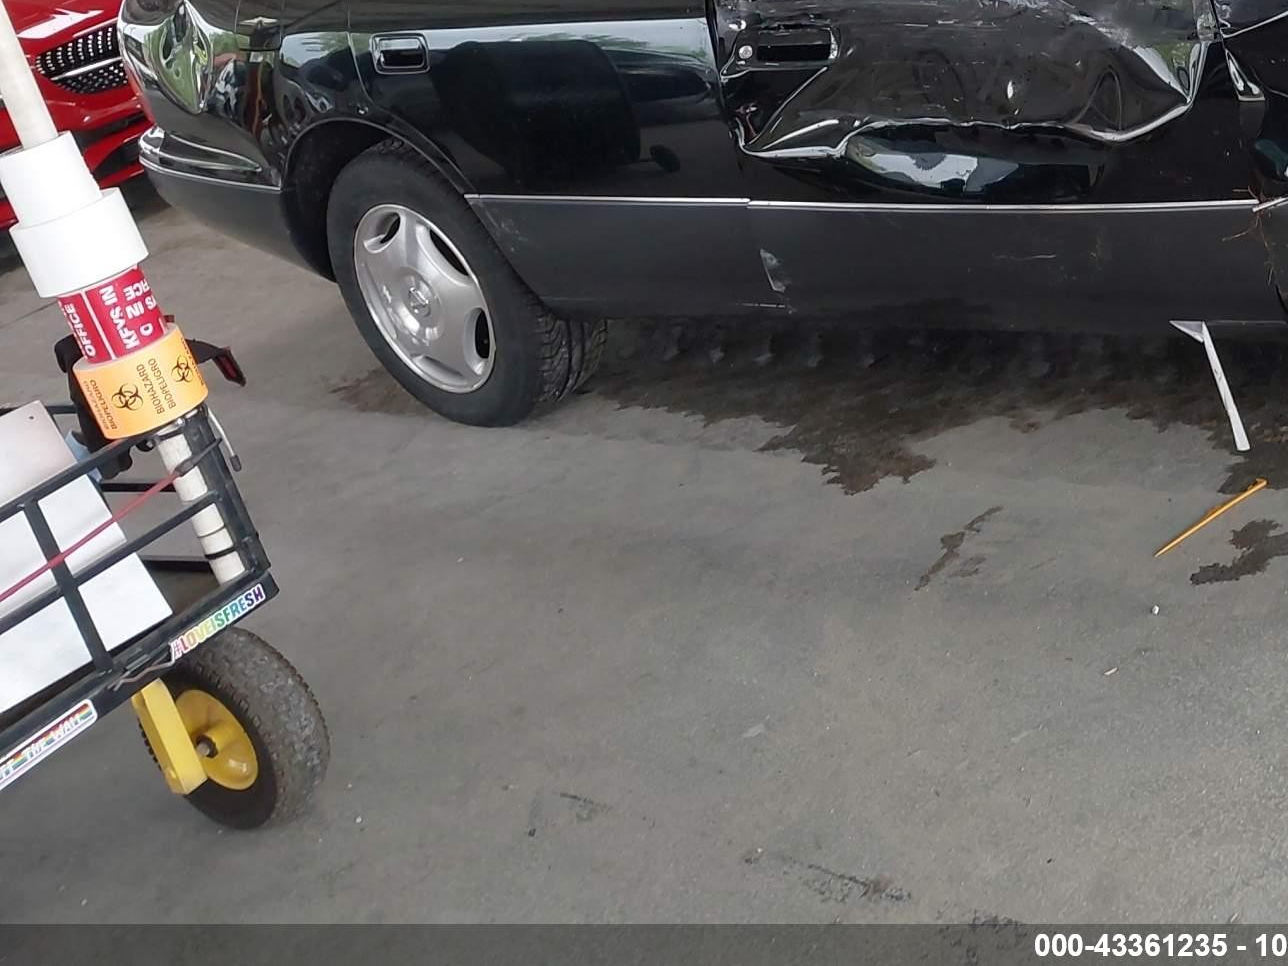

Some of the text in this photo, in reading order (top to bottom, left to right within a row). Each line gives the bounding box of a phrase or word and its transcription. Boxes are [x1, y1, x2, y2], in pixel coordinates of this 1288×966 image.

[100, 285, 119, 307] IN
[65, 302, 97, 358] OFFICE
[135, 362, 166, 416] BIOHAZARD
[147, 357, 177, 410] BIOPELIGRO
[173, 585, 264, 660] #LOVEISFRESH
